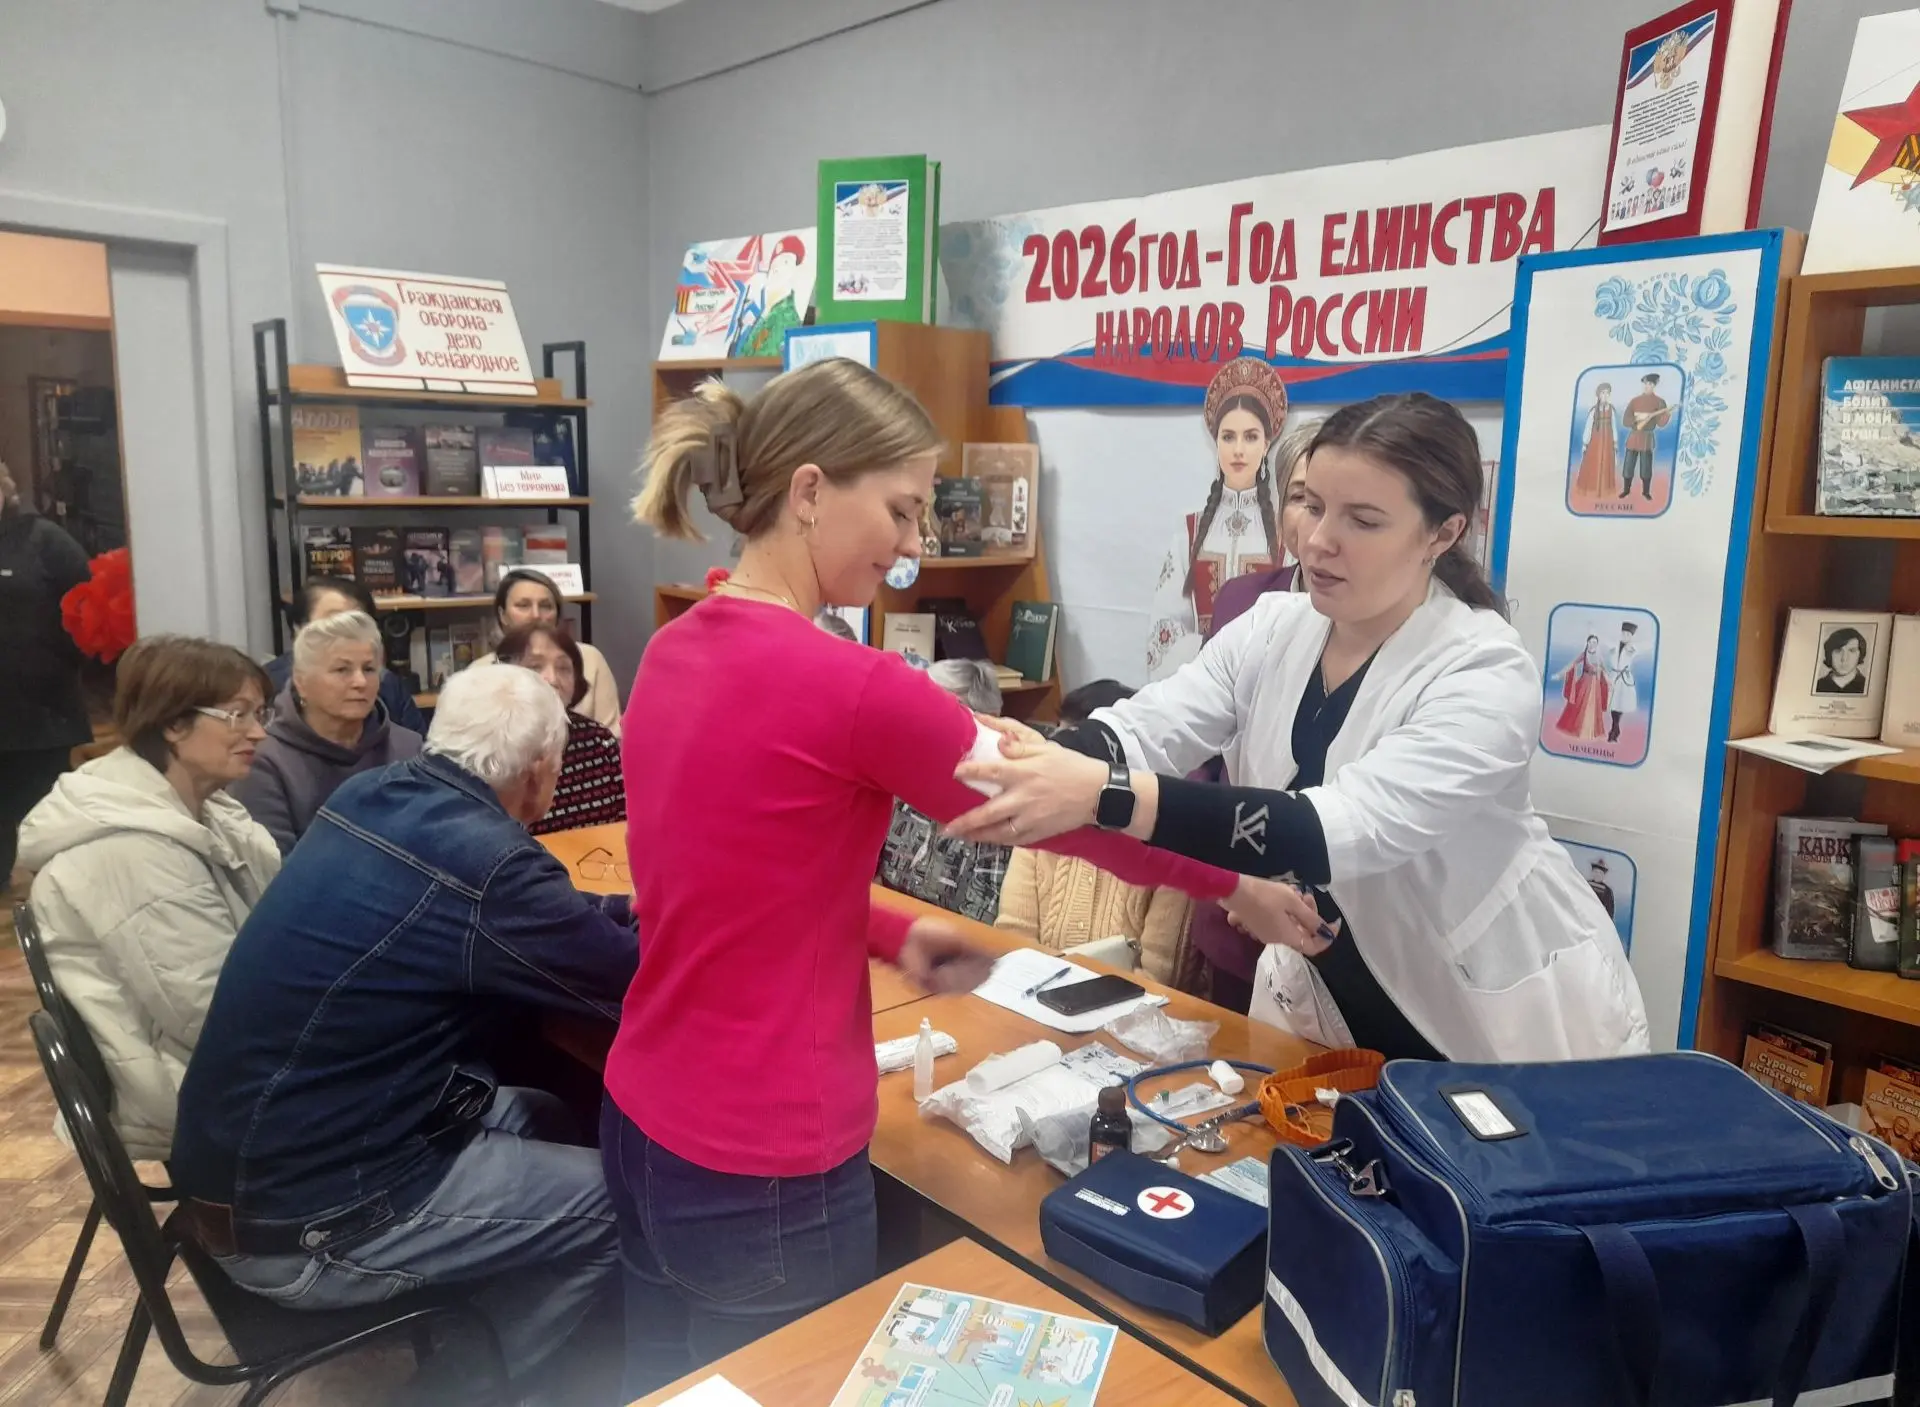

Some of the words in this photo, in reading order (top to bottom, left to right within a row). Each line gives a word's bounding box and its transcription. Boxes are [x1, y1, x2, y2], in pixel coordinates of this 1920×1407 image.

[1320, 187, 1555, 276] ЕДИНСТВА
[396, 280, 504, 314] Гражданская
[445, 331, 482, 351] дело
[1093, 301, 1245, 365] НАРОДОВ
[416, 349, 520, 373] всенародное
[1844, 395, 1889, 408] БОЛИТ
[1749, 1062, 1814, 1093] испытание
[1758, 1053, 1807, 1080] Суровое
